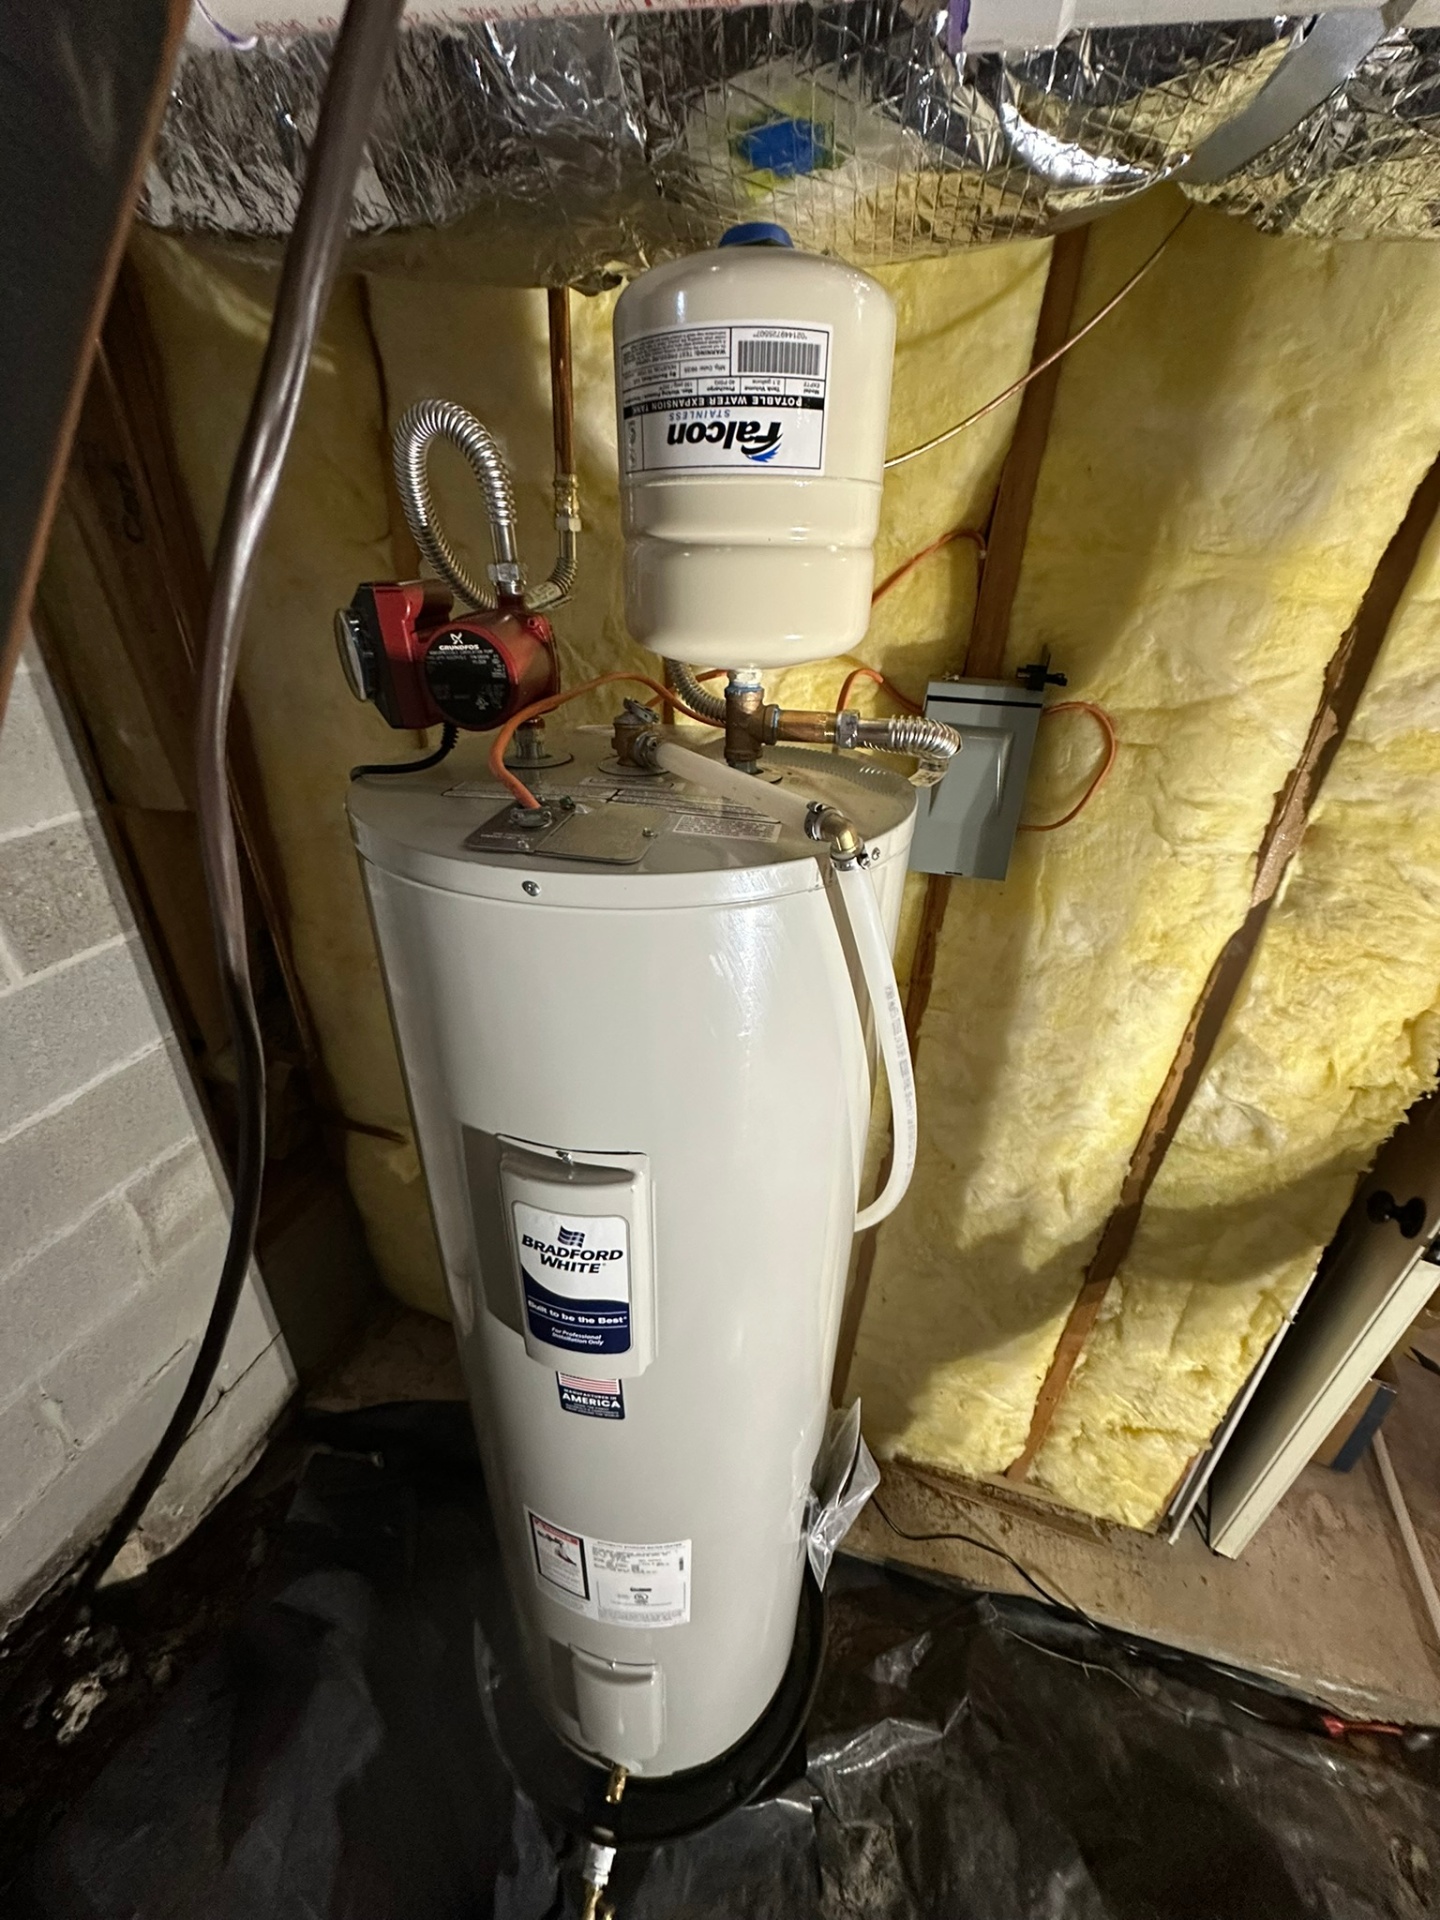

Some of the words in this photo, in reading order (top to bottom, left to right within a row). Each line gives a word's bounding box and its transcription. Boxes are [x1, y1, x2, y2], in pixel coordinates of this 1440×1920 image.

[653, 397, 705, 410] EXPANSION
[709, 396, 748, 406] WATER
[751, 396, 802, 407] POTABLE
[632, 403, 648, 413] TANK
[669, 410, 730, 420] STAINLESS
[667, 421, 783, 463] Falcon
[522, 1234, 623, 1261] BRADFORD
[540, 1253, 601, 1274] WHITE
[528, 1300, 547, 1314] Built
[549, 1308, 559, 1318] to
[561, 1312, 575, 1322] be
[578, 1314, 596, 1324] the
[598, 1316, 624, 1324] Best
[562, 1329, 602, 1340] Professional
[562, 1393, 621, 1408] AMERICA
